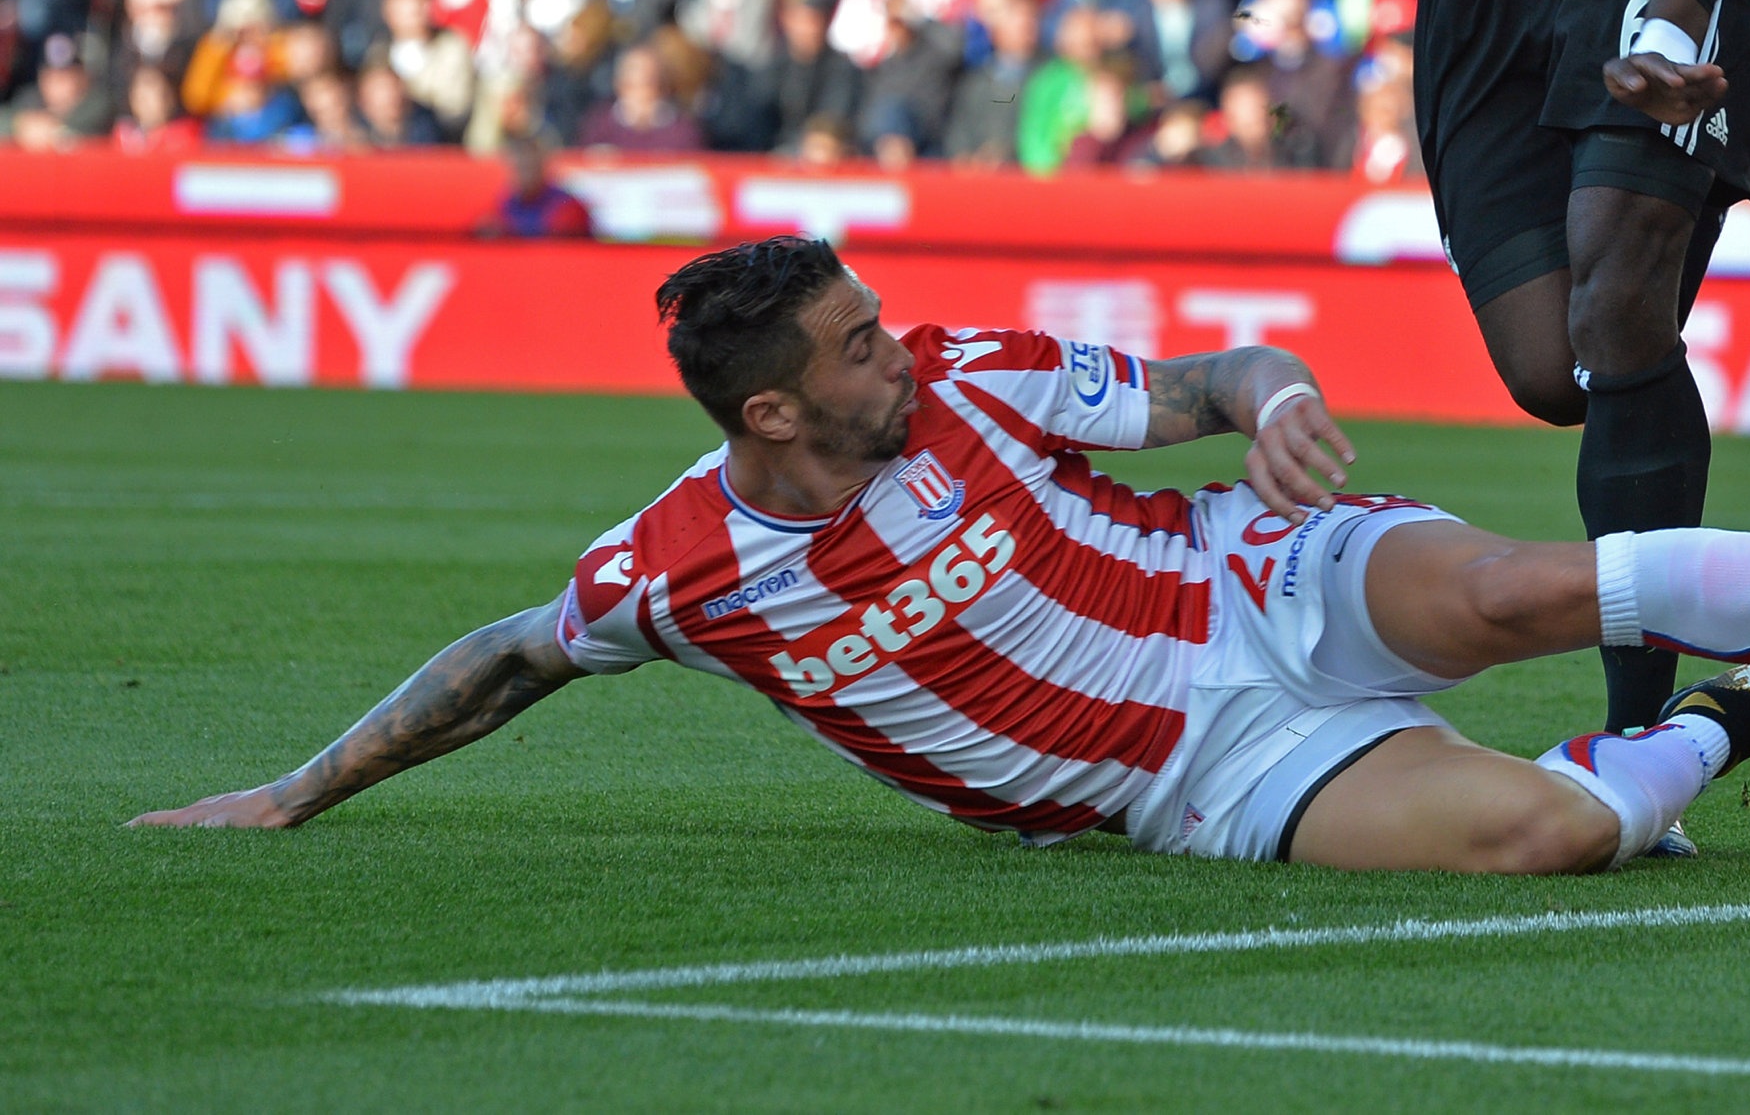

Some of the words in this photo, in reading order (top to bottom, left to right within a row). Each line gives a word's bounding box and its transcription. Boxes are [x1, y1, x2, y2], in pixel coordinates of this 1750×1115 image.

[703, 568, 800, 620] macron
[1281, 510, 1333, 597] macron
[768, 512, 1016, 698] bet365
